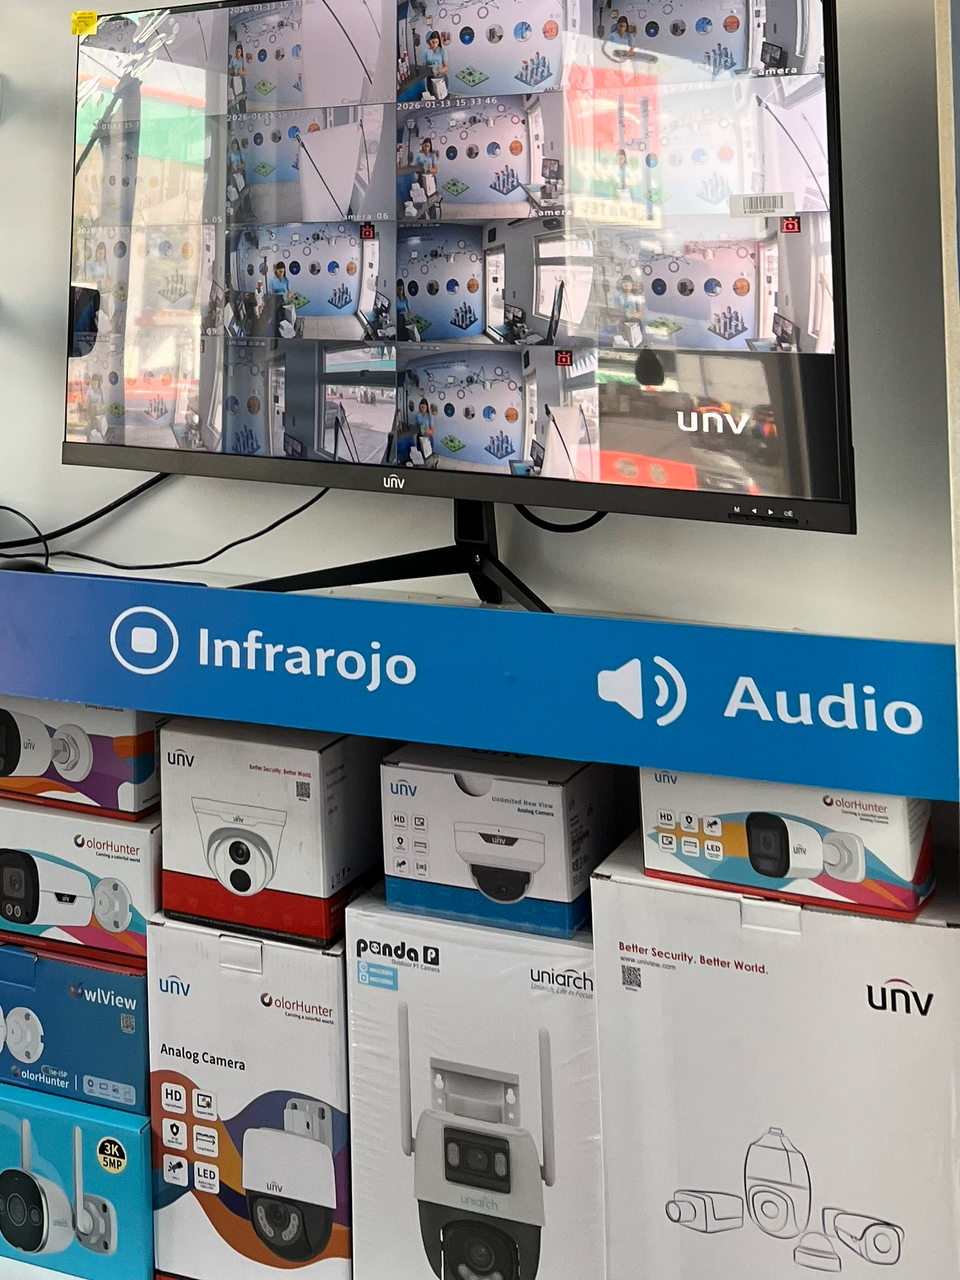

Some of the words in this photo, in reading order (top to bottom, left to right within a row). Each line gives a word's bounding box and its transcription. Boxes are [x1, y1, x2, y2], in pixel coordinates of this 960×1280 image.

[396, 100, 451, 111] 2026-01-13
[376, 212, 389, 220] 06
[199, 627, 417, 693] Infrarojo
[723, 676, 923, 735] Audio
[283, 769, 297, 777] Better
[297, 771, 313, 779] World.
[491, 796, 522, 805] Unlimited
[523, 799, 537, 807] New
[538, 801, 554, 809] View
[393, 814, 405, 824] HD
[660, 812, 673, 821] HD
[706, 844, 721, 853] LED
[356, 938, 419, 962] panda
[619, 941, 649, 956] Better
[699, 955, 732, 970] Better
[733, 960, 769, 975] World.
[620, 955, 677, 972] www.uniview.com
[391, 958, 412, 969] Outdoor
[419, 963, 440, 973] Camera
[530, 968, 594, 992] uniarch
[556, 986, 568, 995] Life
[575, 990, 594, 1000] Focus
[160, 1043, 200, 1065] Analog
[202, 1051, 246, 1071] Camera
[165, 1088, 182, 1101] HD
[103, 1142, 121, 1157] 3K
[102, 1156, 123, 1171] 5MP
[197, 1167, 216, 1180] LED
